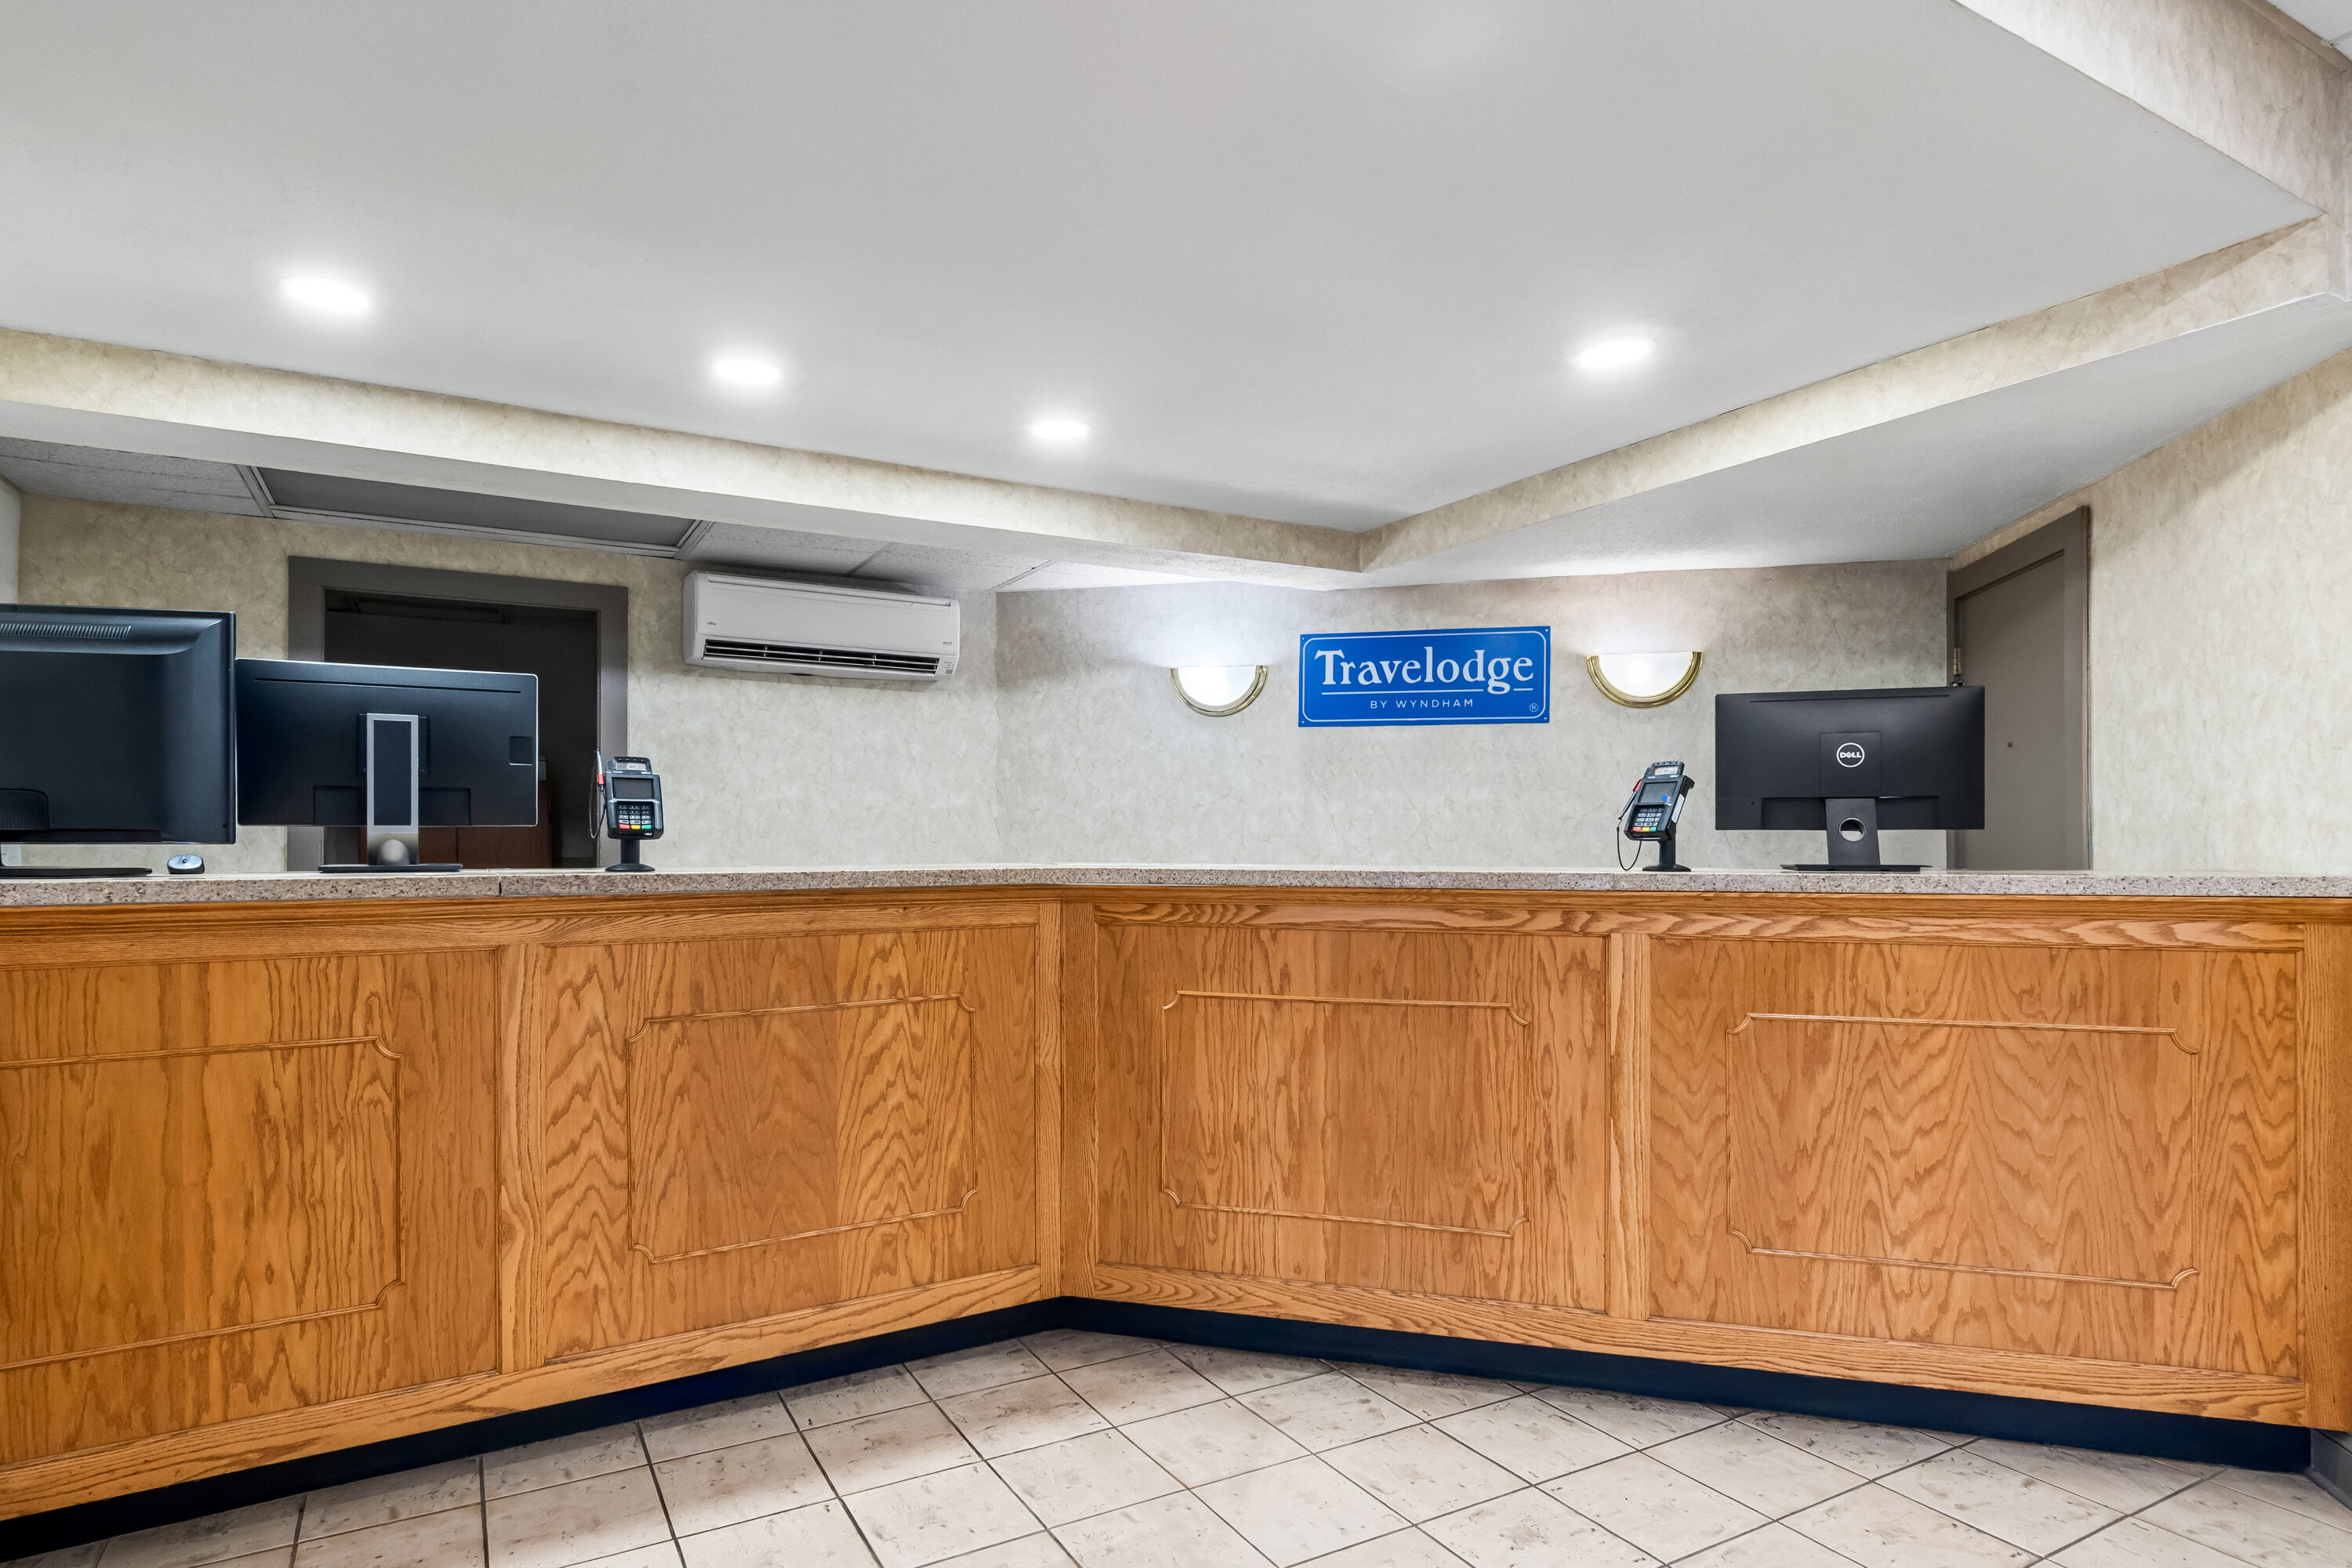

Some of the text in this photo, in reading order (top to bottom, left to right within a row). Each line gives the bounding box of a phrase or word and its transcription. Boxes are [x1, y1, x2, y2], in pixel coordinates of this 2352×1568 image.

[1314, 646, 1534, 695] Travelodge
[1370, 699, 1474, 710] BY WYNDHAM
